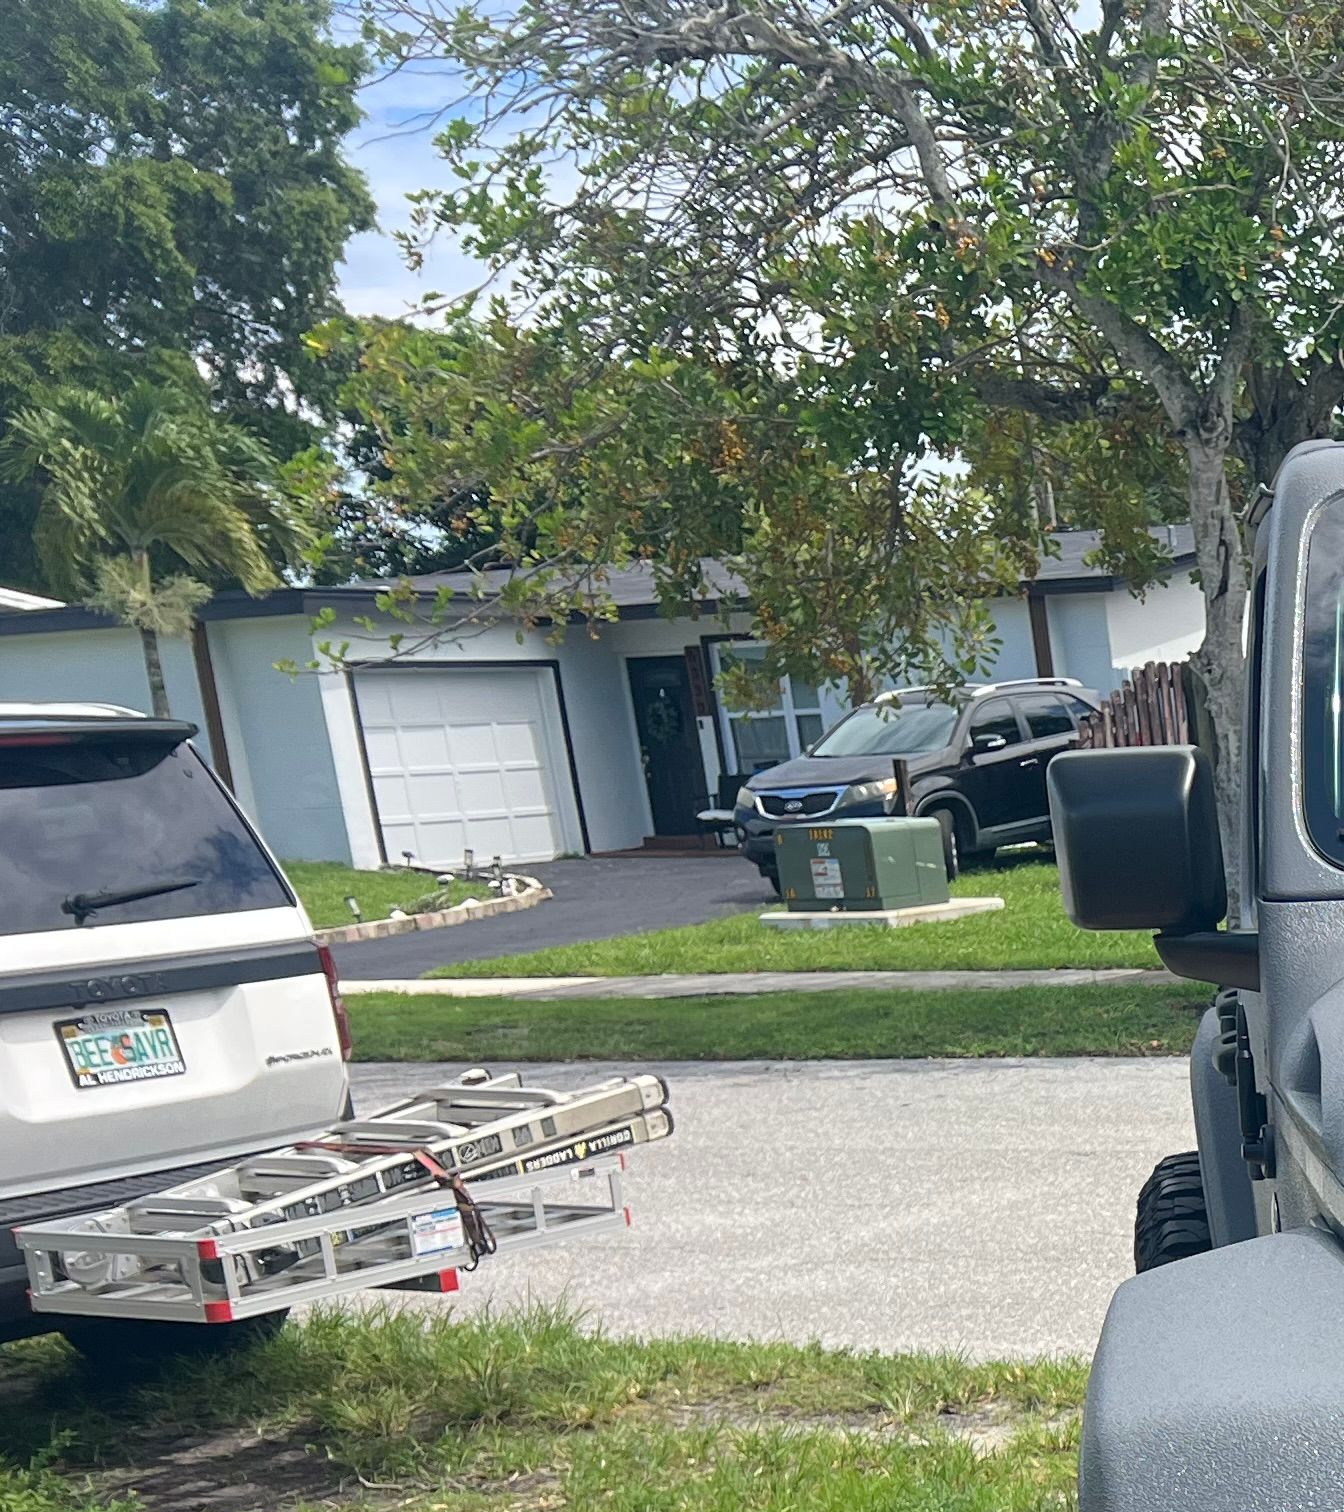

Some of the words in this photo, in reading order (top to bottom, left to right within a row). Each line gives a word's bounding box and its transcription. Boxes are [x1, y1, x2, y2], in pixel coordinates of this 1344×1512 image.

[79, 1074, 98, 1087] AL
[99, 1062, 184, 1084] HENDRICKSON
[589, 1129, 631, 1151] GORILLA
[526, 1148, 574, 1171] LADDERS
